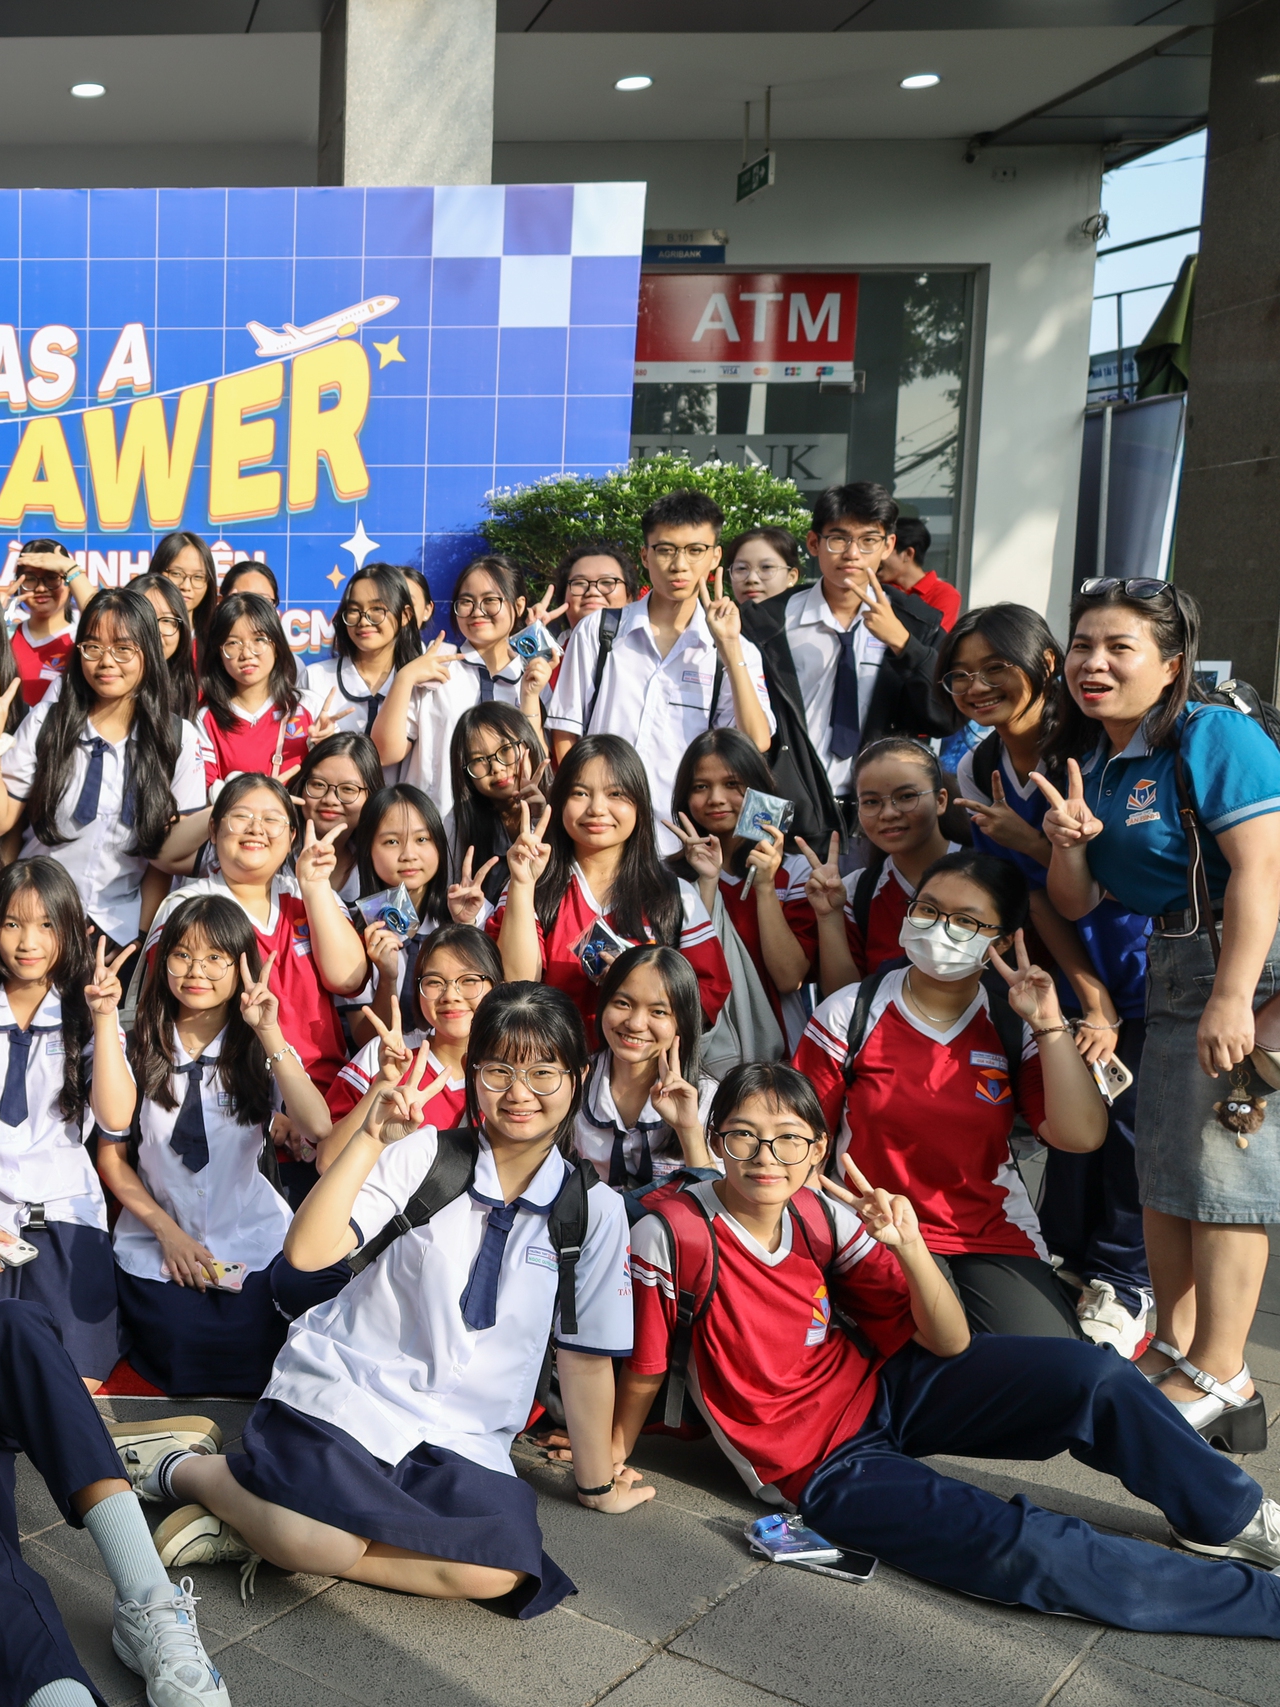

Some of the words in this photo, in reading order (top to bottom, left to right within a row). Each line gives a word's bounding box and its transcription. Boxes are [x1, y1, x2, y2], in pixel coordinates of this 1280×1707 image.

[658, 250, 702, 259] AGRIBANK
[692, 292, 841, 342] ATM
[97, 321, 152, 401] A
[722, 367, 739, 375] VISA
[68, 549, 152, 588] INH
